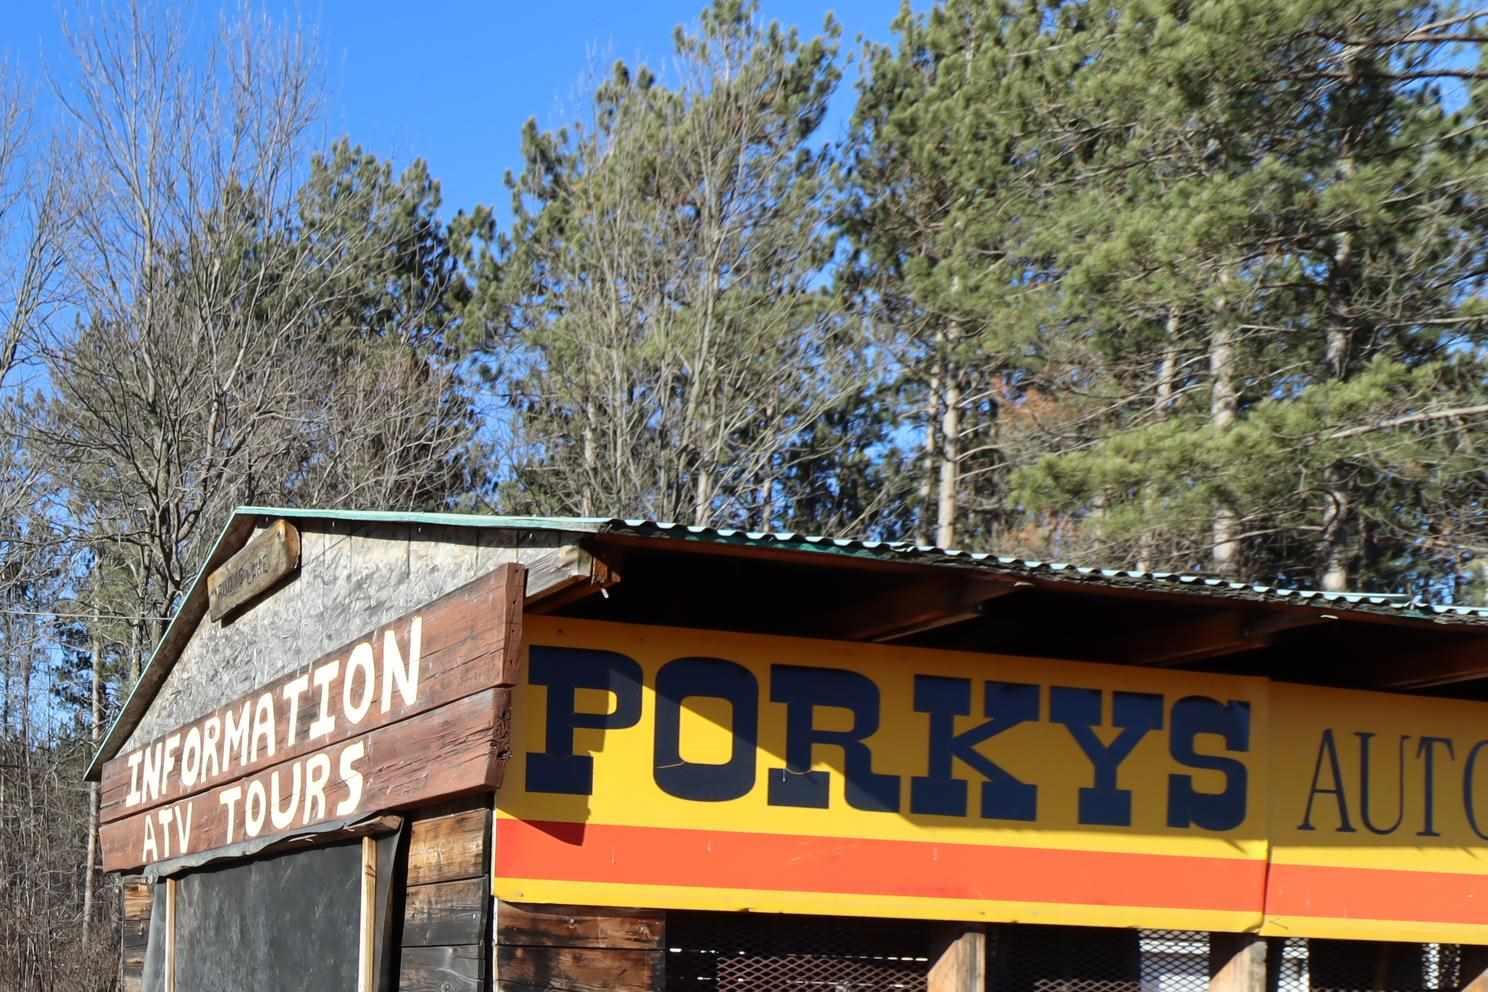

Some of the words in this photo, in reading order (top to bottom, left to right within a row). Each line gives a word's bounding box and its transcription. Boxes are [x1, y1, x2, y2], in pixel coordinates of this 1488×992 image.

[125, 615, 422, 808] INFORMATION
[142, 802, 193, 862] ATV
[219, 740, 365, 844] TOURS
[524, 644, 1251, 831] PORKYS
